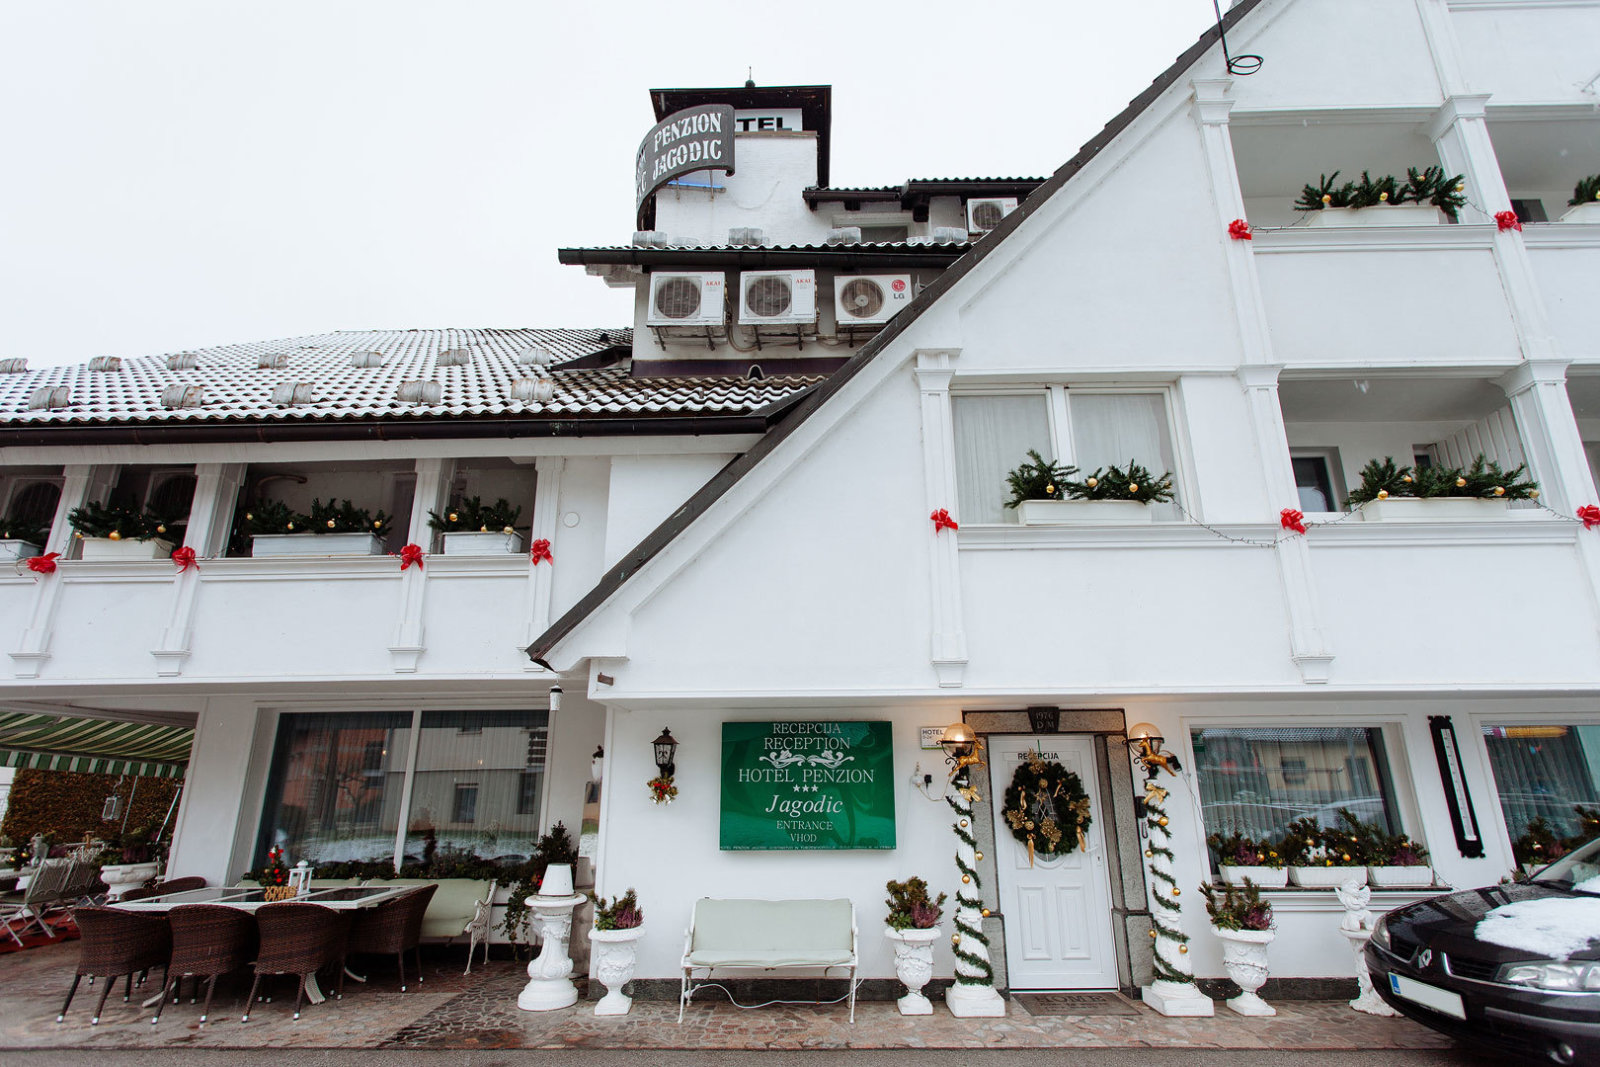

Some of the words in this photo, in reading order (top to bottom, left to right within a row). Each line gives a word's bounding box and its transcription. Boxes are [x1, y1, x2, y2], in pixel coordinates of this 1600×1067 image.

[736, 117, 792, 132] TEL
[654, 112, 722, 153] PENZION
[652, 139, 722, 181] JAGODIC
[772, 722, 842, 734] RECEPCIJA
[764, 737, 851, 750] RECEPTION
[1017, 752, 1060, 760] REEPCIJA
[738, 768, 795, 783] HOTEL
[802, 769, 875, 783] PENZION
[765, 794, 844, 818] Jagodic
[776, 820, 834, 831] ENTRANCE
[790, 833, 817, 842] VHOD
